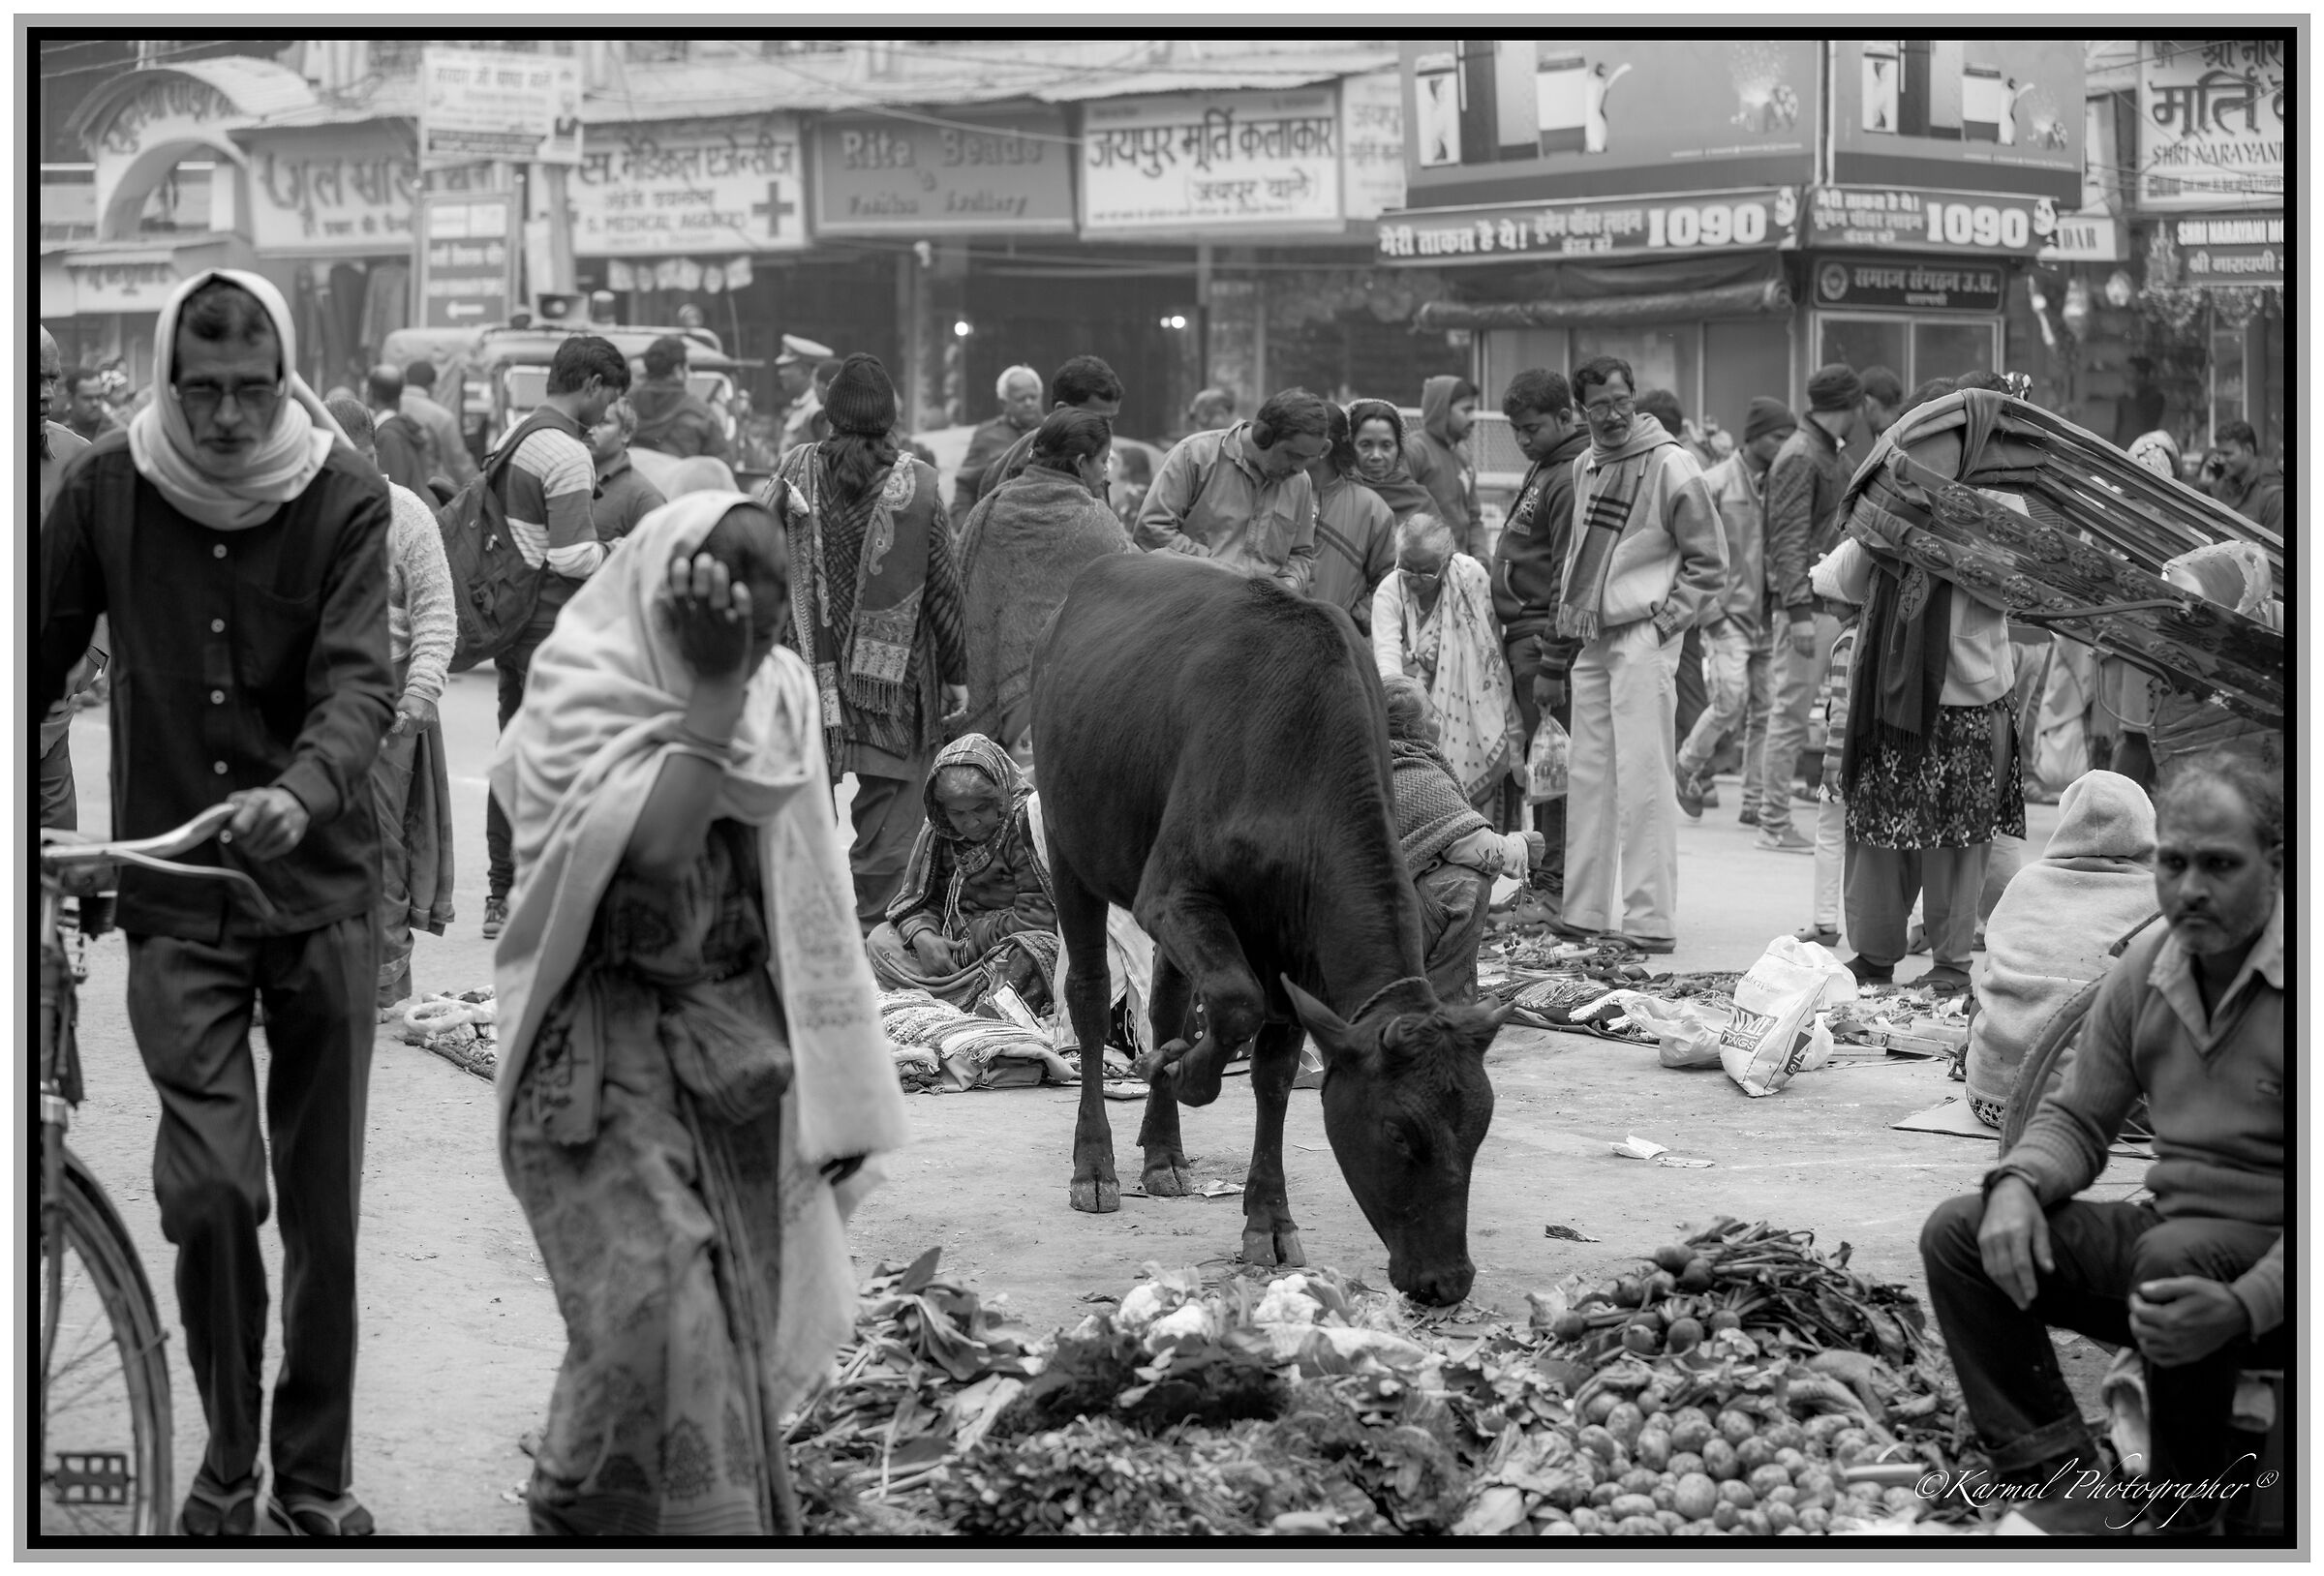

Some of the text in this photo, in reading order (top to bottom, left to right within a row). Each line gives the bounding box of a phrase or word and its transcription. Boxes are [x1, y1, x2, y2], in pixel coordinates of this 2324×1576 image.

[1087, 106, 1335, 178] जयपुर मूर्ति कलाकार
[1647, 203, 1768, 248] 1090
[1927, 201, 2030, 249] 1090
[1853, 266, 1905, 288] समाज
